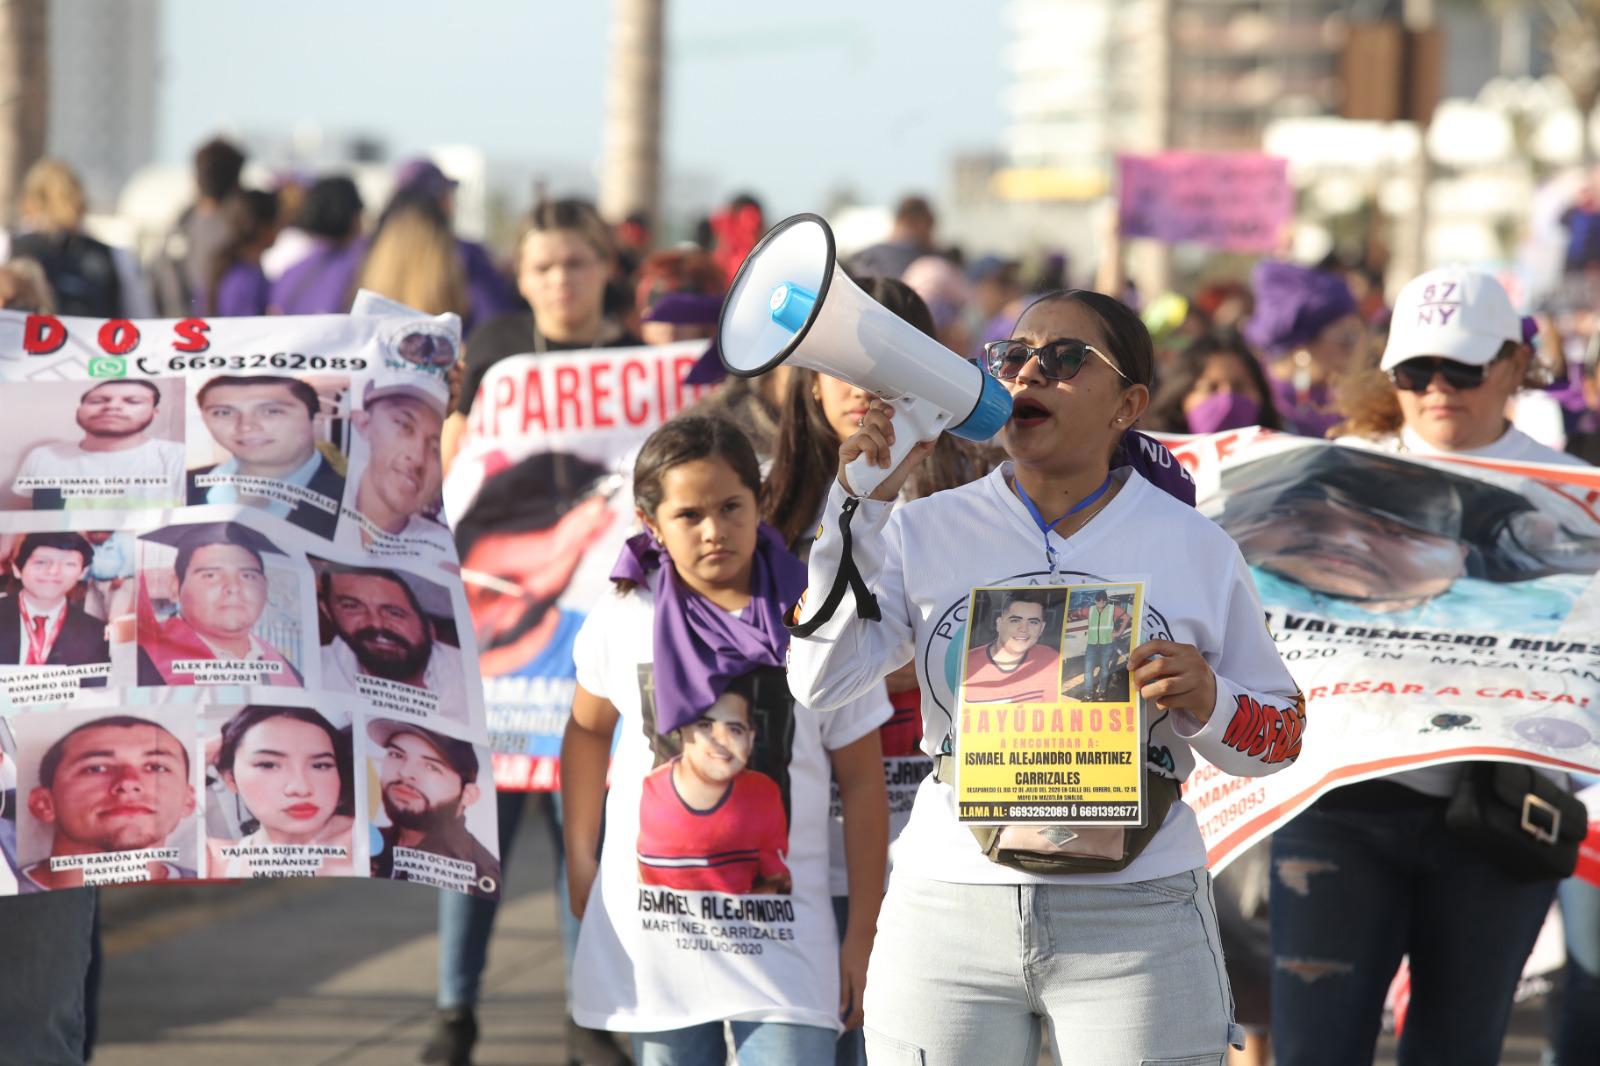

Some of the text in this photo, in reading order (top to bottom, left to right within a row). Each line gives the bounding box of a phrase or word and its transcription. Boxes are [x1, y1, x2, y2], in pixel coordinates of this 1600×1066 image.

[1417, 307, 1455, 326] NY
[168, 353, 367, 371] 6693262089
[59, 478, 100, 486] ISMAEL
[1363, 650, 1404, 661] EN
[42, 665, 113, 680] GUADALUPE
[173, 661, 202, 671] ALEX
[248, 662, 280, 672] SOTO
[8, 680, 80, 694] ROMERO GIL
[1434, 686, 1461, 697] A
[1475, 687, 1591, 709] CASA!
[963, 704, 1136, 733] ¡AYÚDANOS!
[1013, 737, 1081, 749] ENCONTRAR
[965, 750, 1132, 766] ISMAEL ALEJANDRO MARTINEZ
[1015, 771, 1081, 786] CARRIZALES
[1025, 786, 1038, 794] JULIO
[959, 804, 1138, 818] LLAMA AL: 6693262089 Ó 6691392677
[221, 845, 348, 858] YAJAIRA SUJEY PARRA
[51, 849, 180, 870] JESÚS RAMÓN VALDEZ
[427, 855, 474, 872] OCTAVIO
[637, 888, 795, 923] ISMAEL ALEJANDRO
[641, 918, 795, 941] MARTÍNEZ CARRIZALES
[675, 937, 764, 956] 12/JULIO/2020
